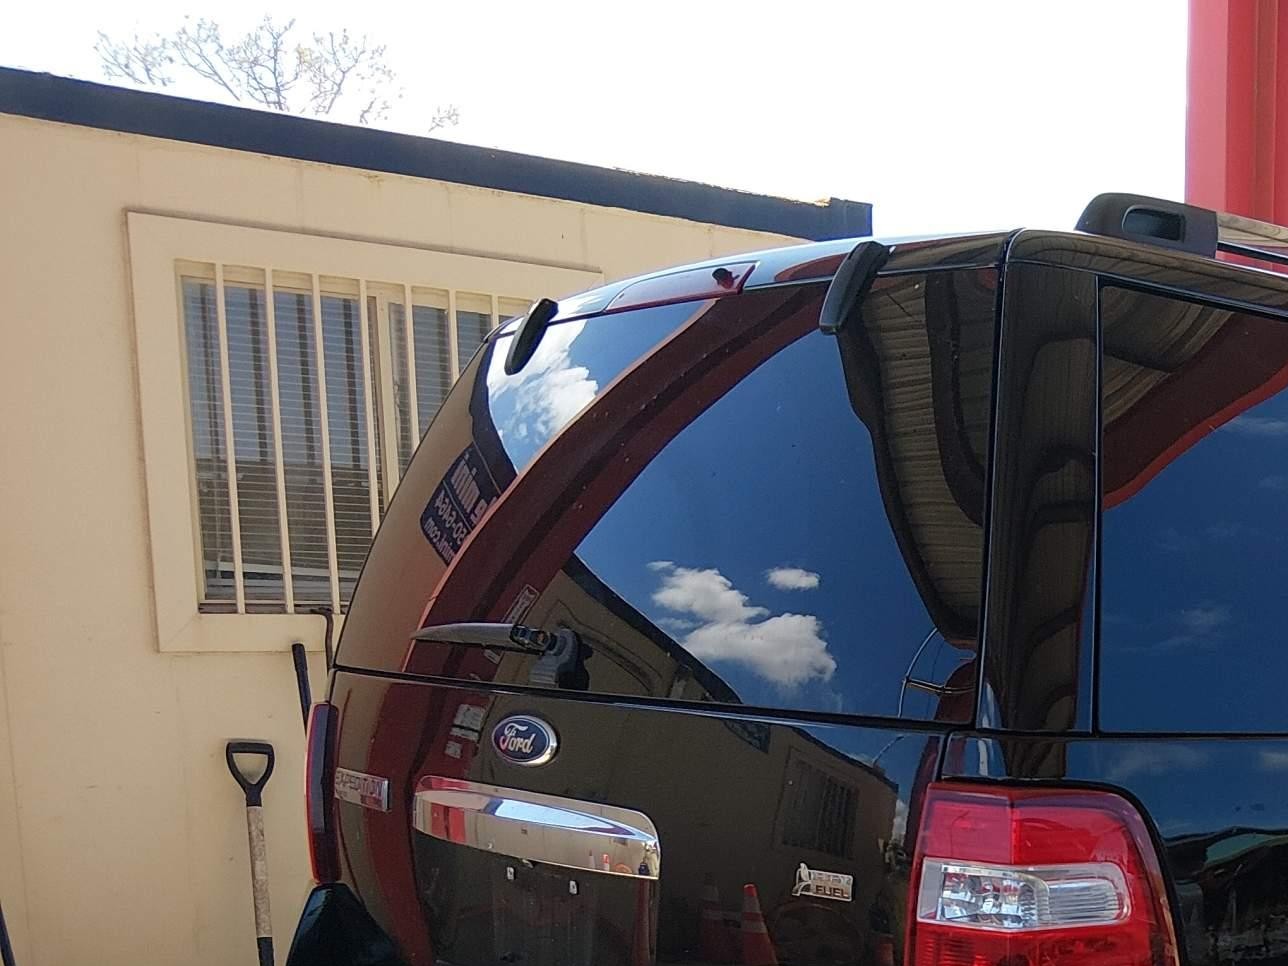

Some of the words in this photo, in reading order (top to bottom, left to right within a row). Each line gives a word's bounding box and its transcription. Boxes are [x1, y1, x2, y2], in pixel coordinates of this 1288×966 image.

[499, 722, 536, 753] Ford
[335, 769, 383, 796] EXPEDITION
[816, 885, 849, 898] FUEL
